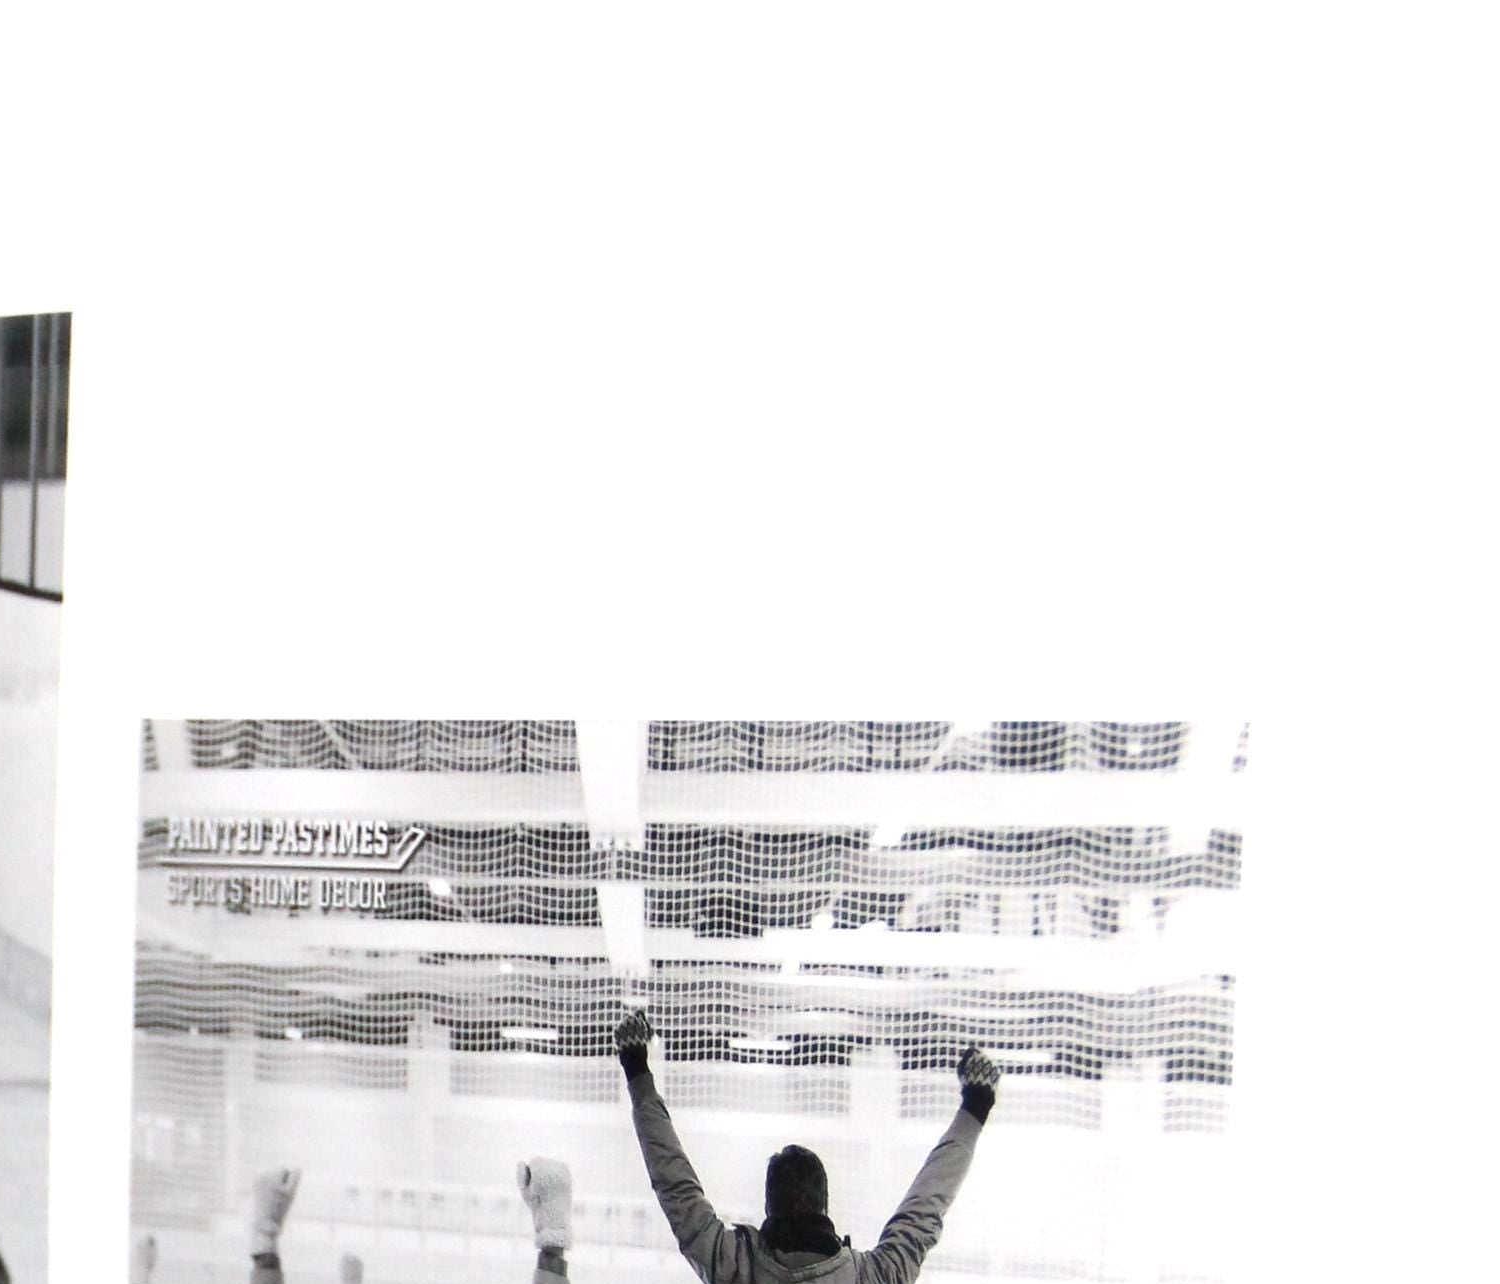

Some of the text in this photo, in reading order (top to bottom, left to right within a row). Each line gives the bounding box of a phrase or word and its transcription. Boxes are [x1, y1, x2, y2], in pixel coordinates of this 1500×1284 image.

[167, 817, 388, 855] PAINTED PASTIMES
[167, 875, 388, 909] SPORTS HOME DECOR
